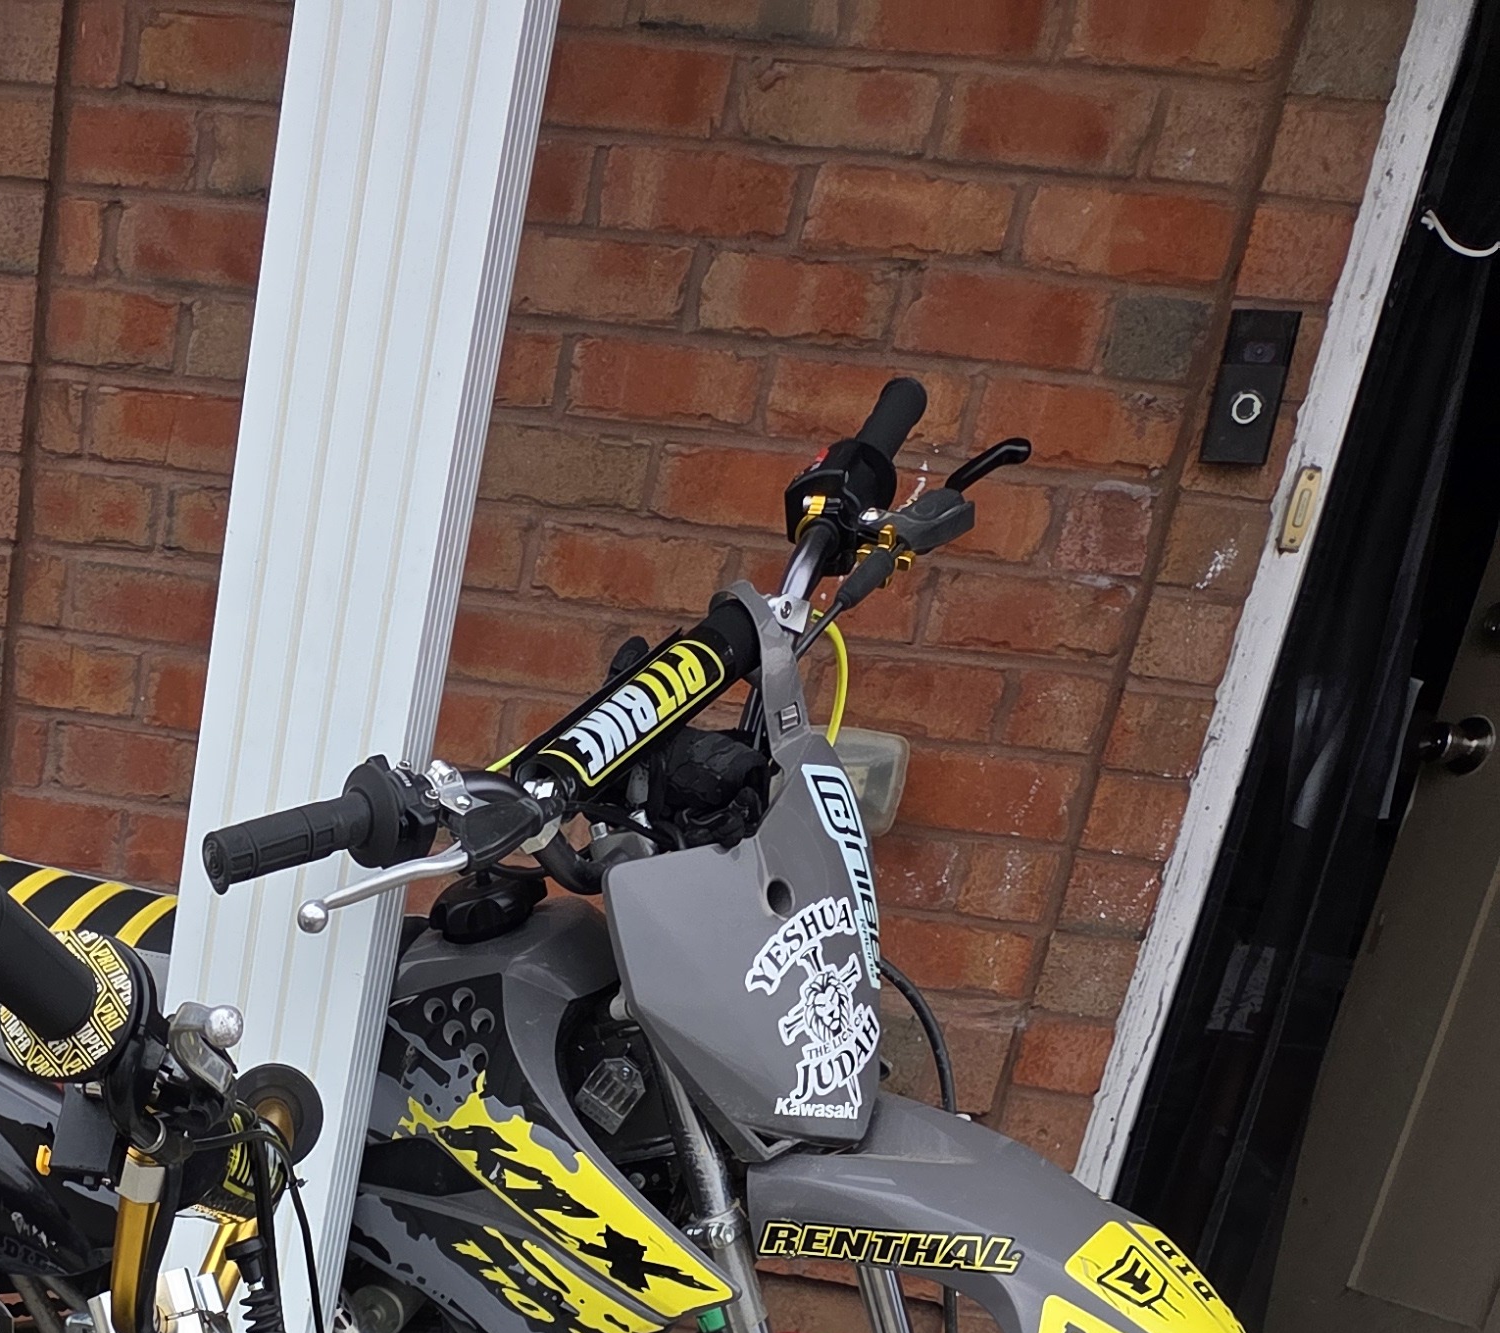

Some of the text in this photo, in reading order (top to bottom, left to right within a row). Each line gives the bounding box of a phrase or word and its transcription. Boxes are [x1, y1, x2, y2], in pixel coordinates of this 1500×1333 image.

[753, 903, 853, 984] YESHUA
[795, 1018, 877, 1100] JUDAH
[774, 1097, 859, 1120] Kawasaki
[757, 1222, 1024, 1273] RENTHAL
